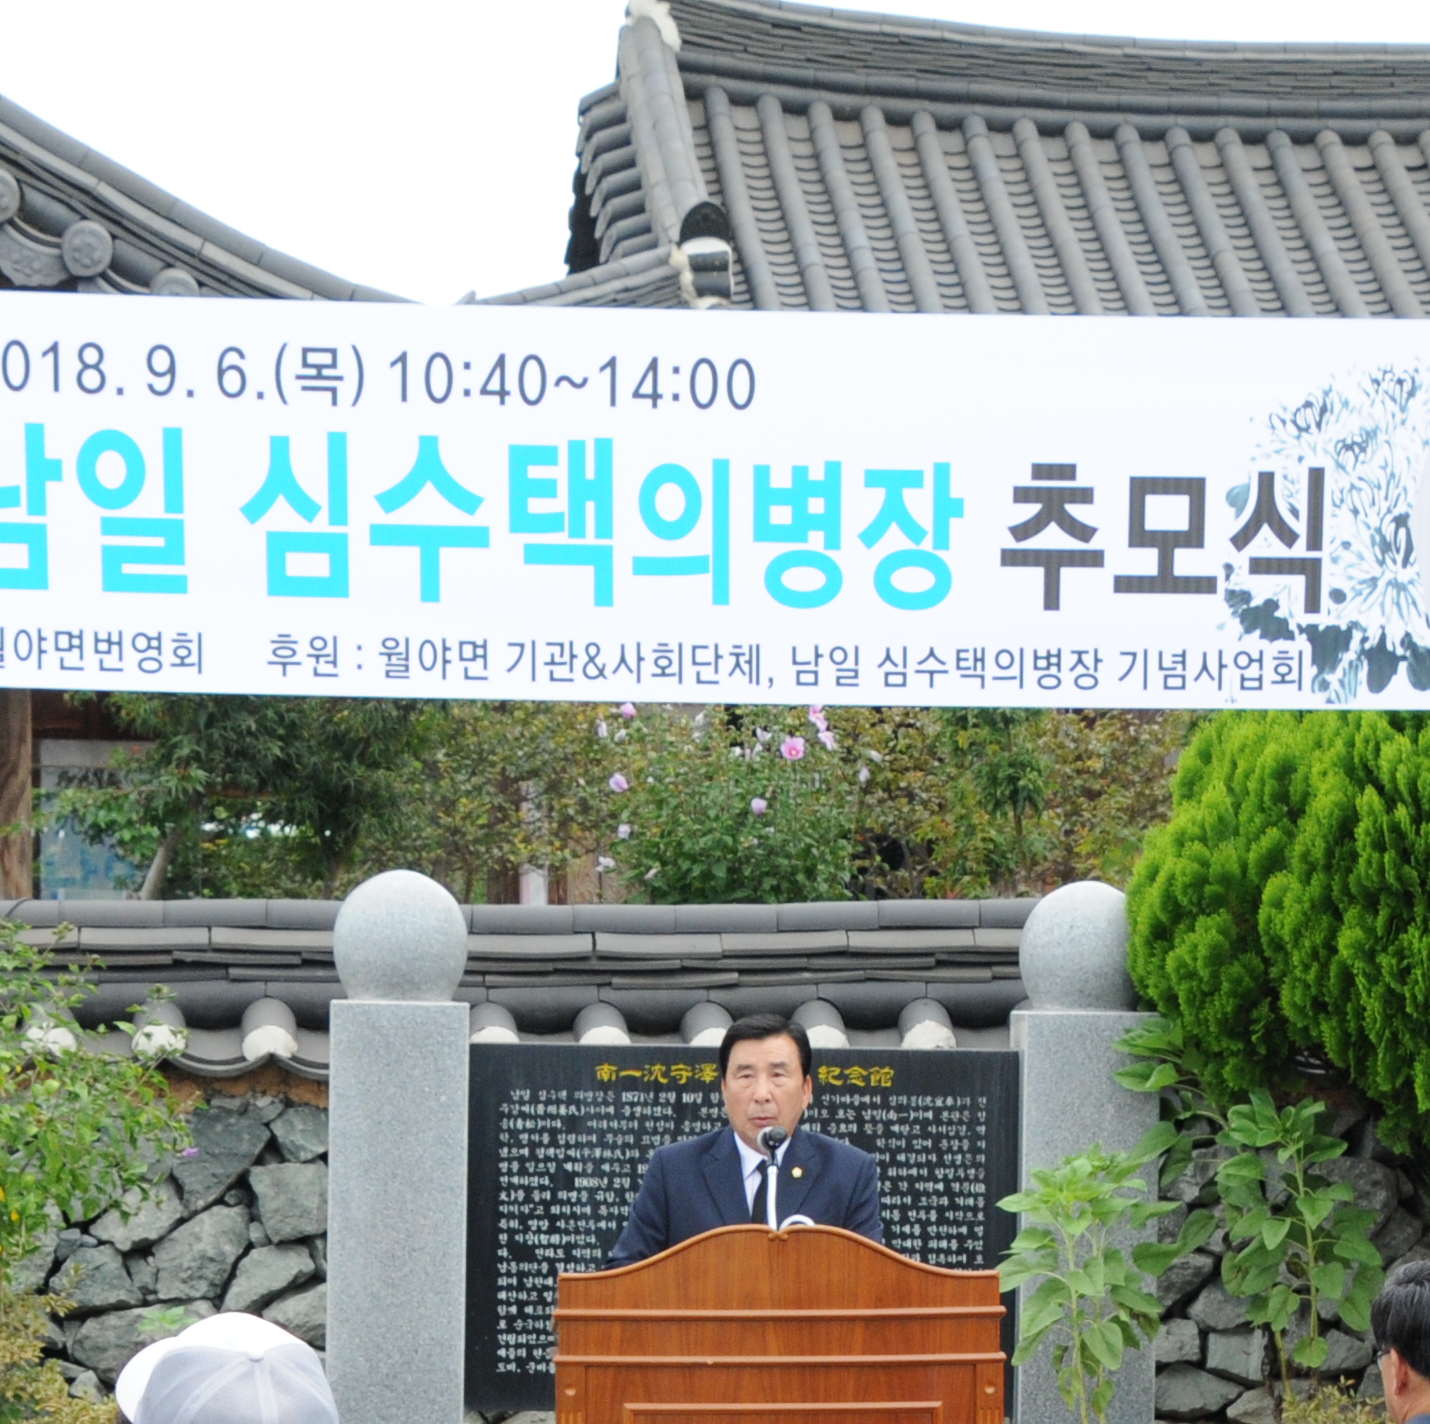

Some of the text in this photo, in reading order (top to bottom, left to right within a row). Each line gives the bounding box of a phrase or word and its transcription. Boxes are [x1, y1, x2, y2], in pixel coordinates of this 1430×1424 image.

[388, 349, 757, 410] 10:40~14:00
[239, 431, 964, 610] 심수택의병장
[1000, 462, 1325, 615] 추모식
[267, 633, 339, 678] 후원
[378, 636, 490, 680] 월야면
[505, 638, 776, 689] 기관&사회단체,
[790, 644, 861, 686] 남일
[877, 645, 1102, 689] 심수택의병장
[1118, 648, 1306, 692] 기념사업회
